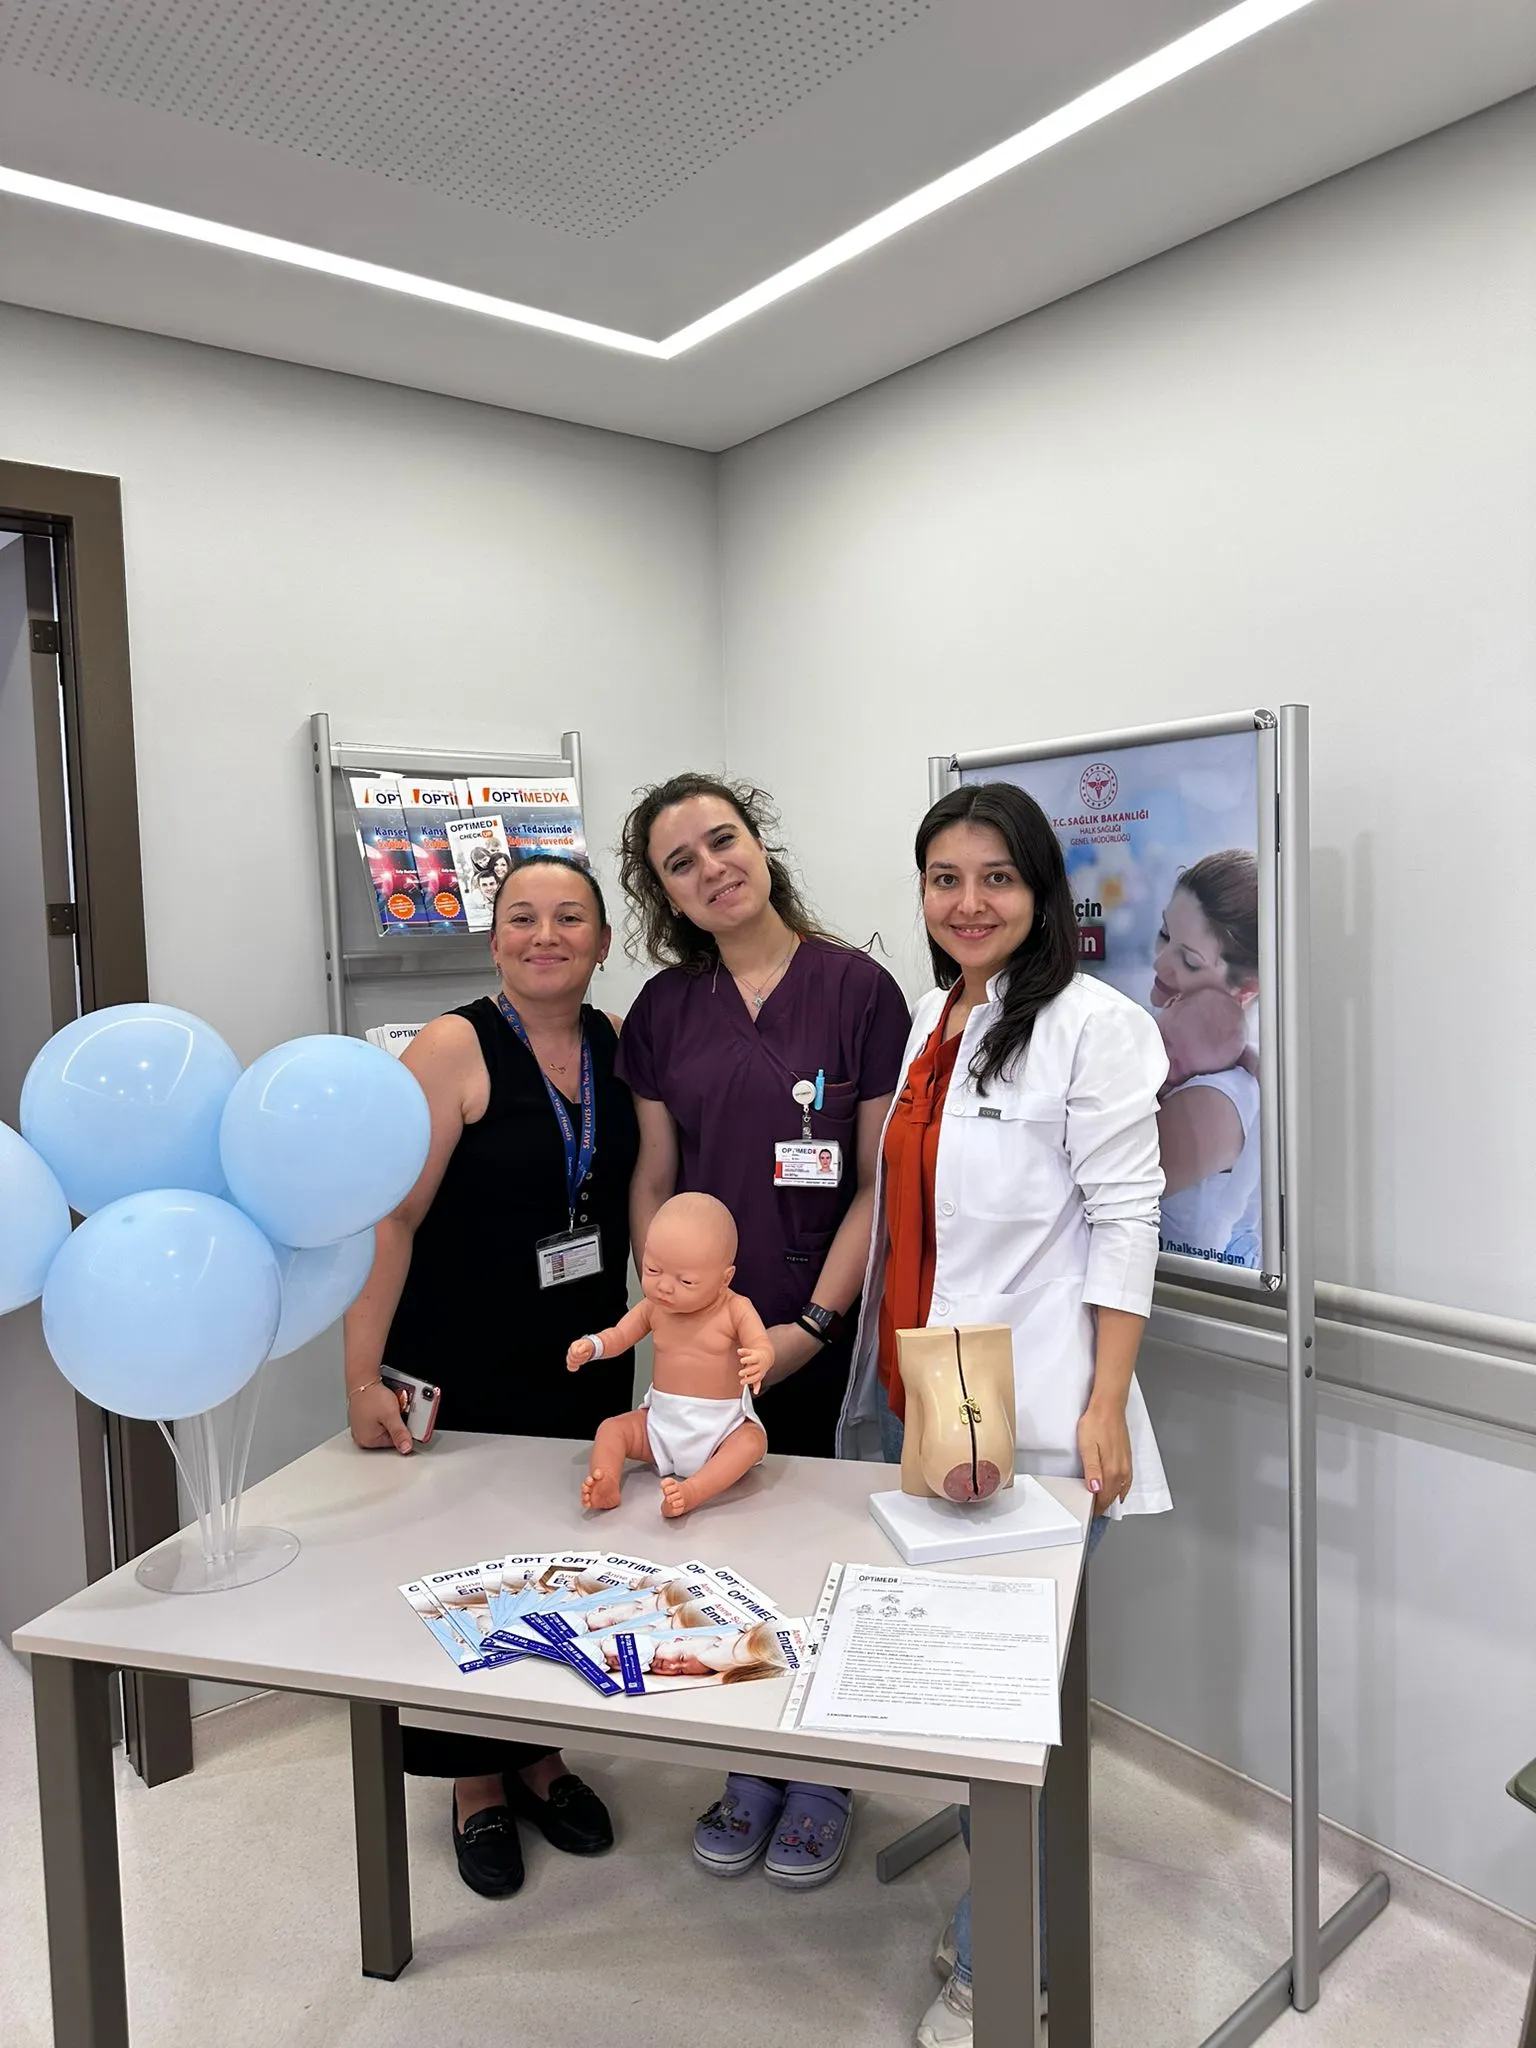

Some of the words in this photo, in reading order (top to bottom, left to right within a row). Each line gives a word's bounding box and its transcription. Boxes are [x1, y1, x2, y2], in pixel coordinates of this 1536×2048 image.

[1053, 818, 1067, 827] T.C.
[1068, 815, 1099, 826] SAĞLIK
[1101, 809, 1149, 823] BAKANLIĞI
[522, 823, 572, 834] Tedavisinde
[1080, 826, 1096, 834] HALK
[1070, 837, 1090, 846] GENEL
[554, 1099, 565, 1117] Your
[560, 1115, 573, 1142] Hands
[582, 1129, 590, 1149] SAVE
[776, 1629, 801, 1670] Emzirme
